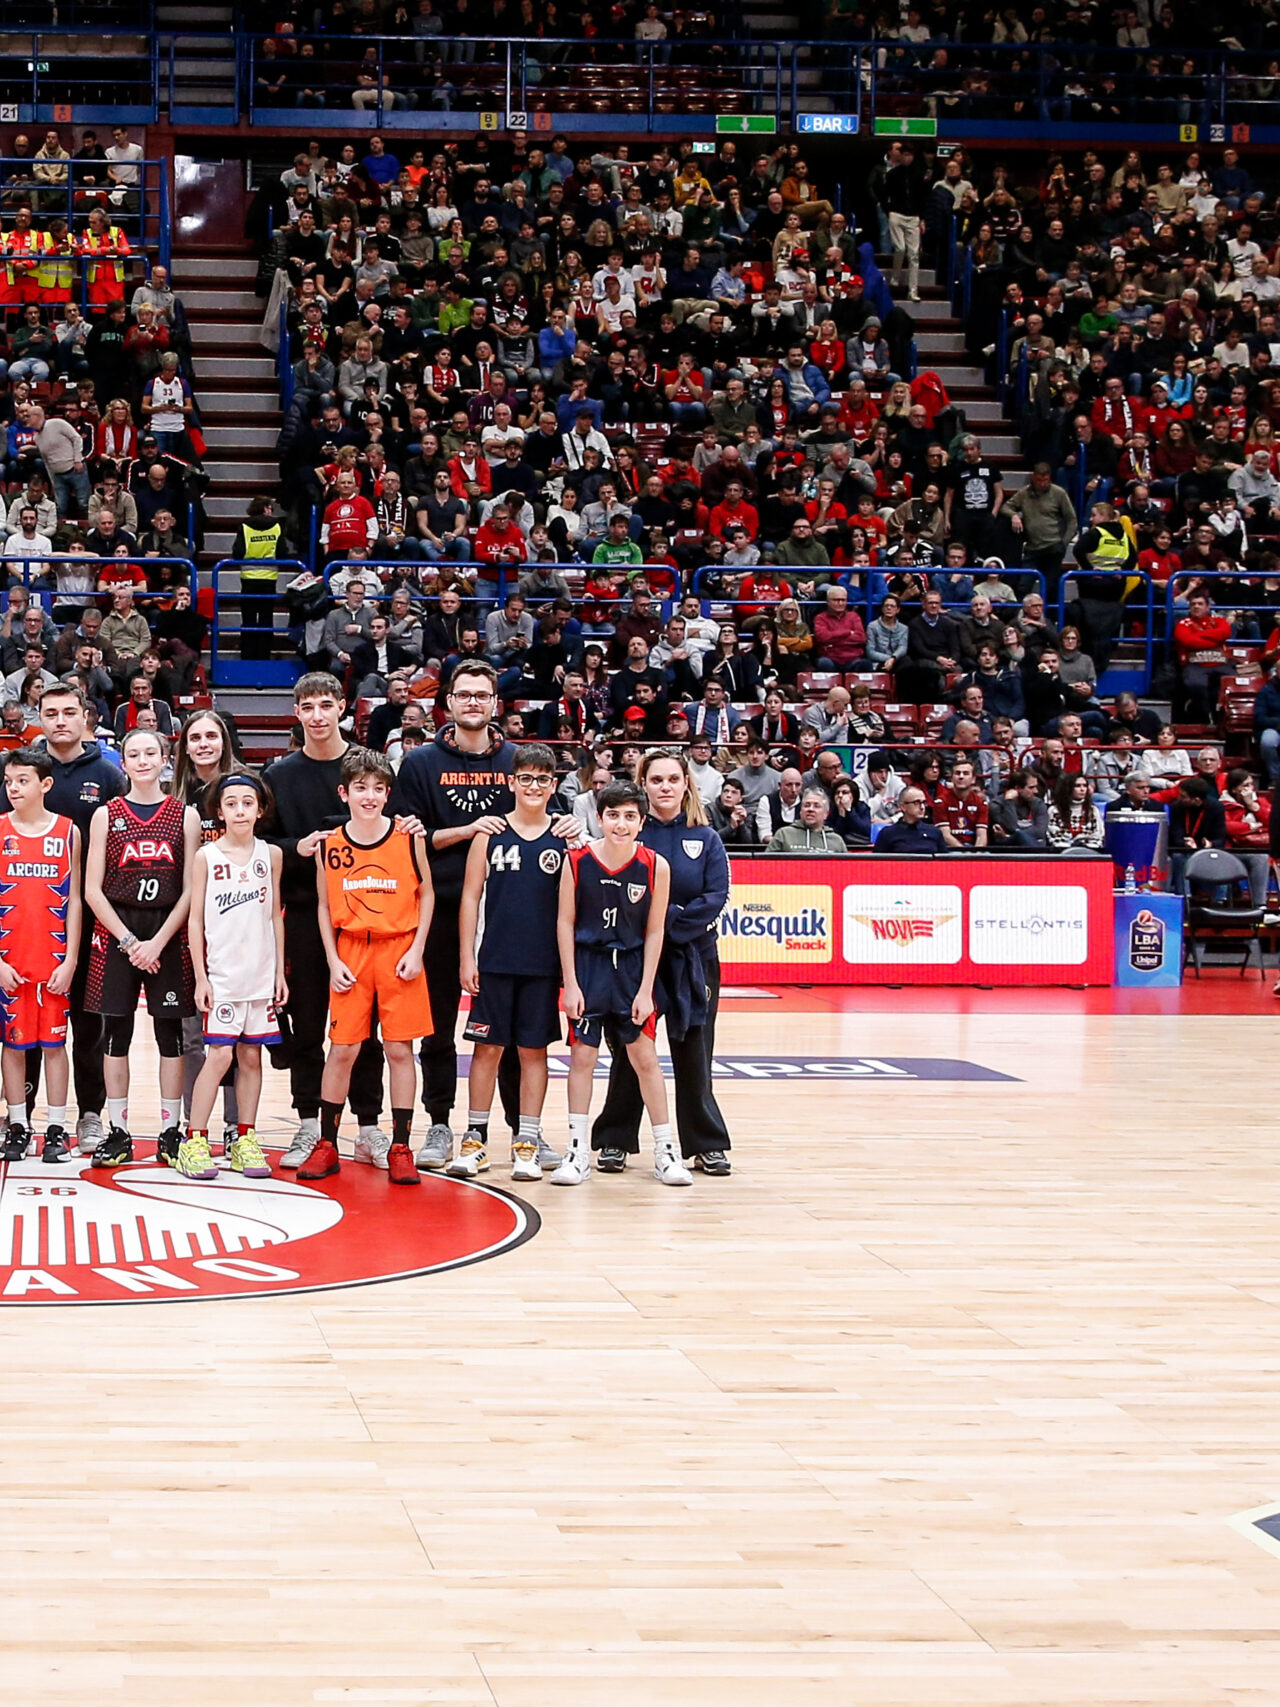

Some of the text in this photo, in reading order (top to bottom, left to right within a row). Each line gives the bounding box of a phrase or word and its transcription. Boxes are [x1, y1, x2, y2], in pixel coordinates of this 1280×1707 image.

[2, 106, 16, 118] 21
[510, 114, 526, 126] 22
[813, 117, 843, 131] BAR
[163, 388, 173, 396] 33
[43, 836, 64, 858] 60
[120, 840, 175, 866] ABA
[327, 845, 355, 870] 63
[491, 844, 521, 872] 44
[6, 862, 59, 878] ARCORE
[213, 864, 232, 881] 21
[136, 879, 160, 902] 19
[602, 907, 618, 929] 91
[722, 907, 826, 944] Nesquik
[975, 919, 1082, 930] STELLANTIS
[786, 938, 826, 951] Snack
[1134, 935, 1160, 945] LBA
[1136, 955, 1158, 965] Unipol
[17, 1186, 78, 1196] 36
